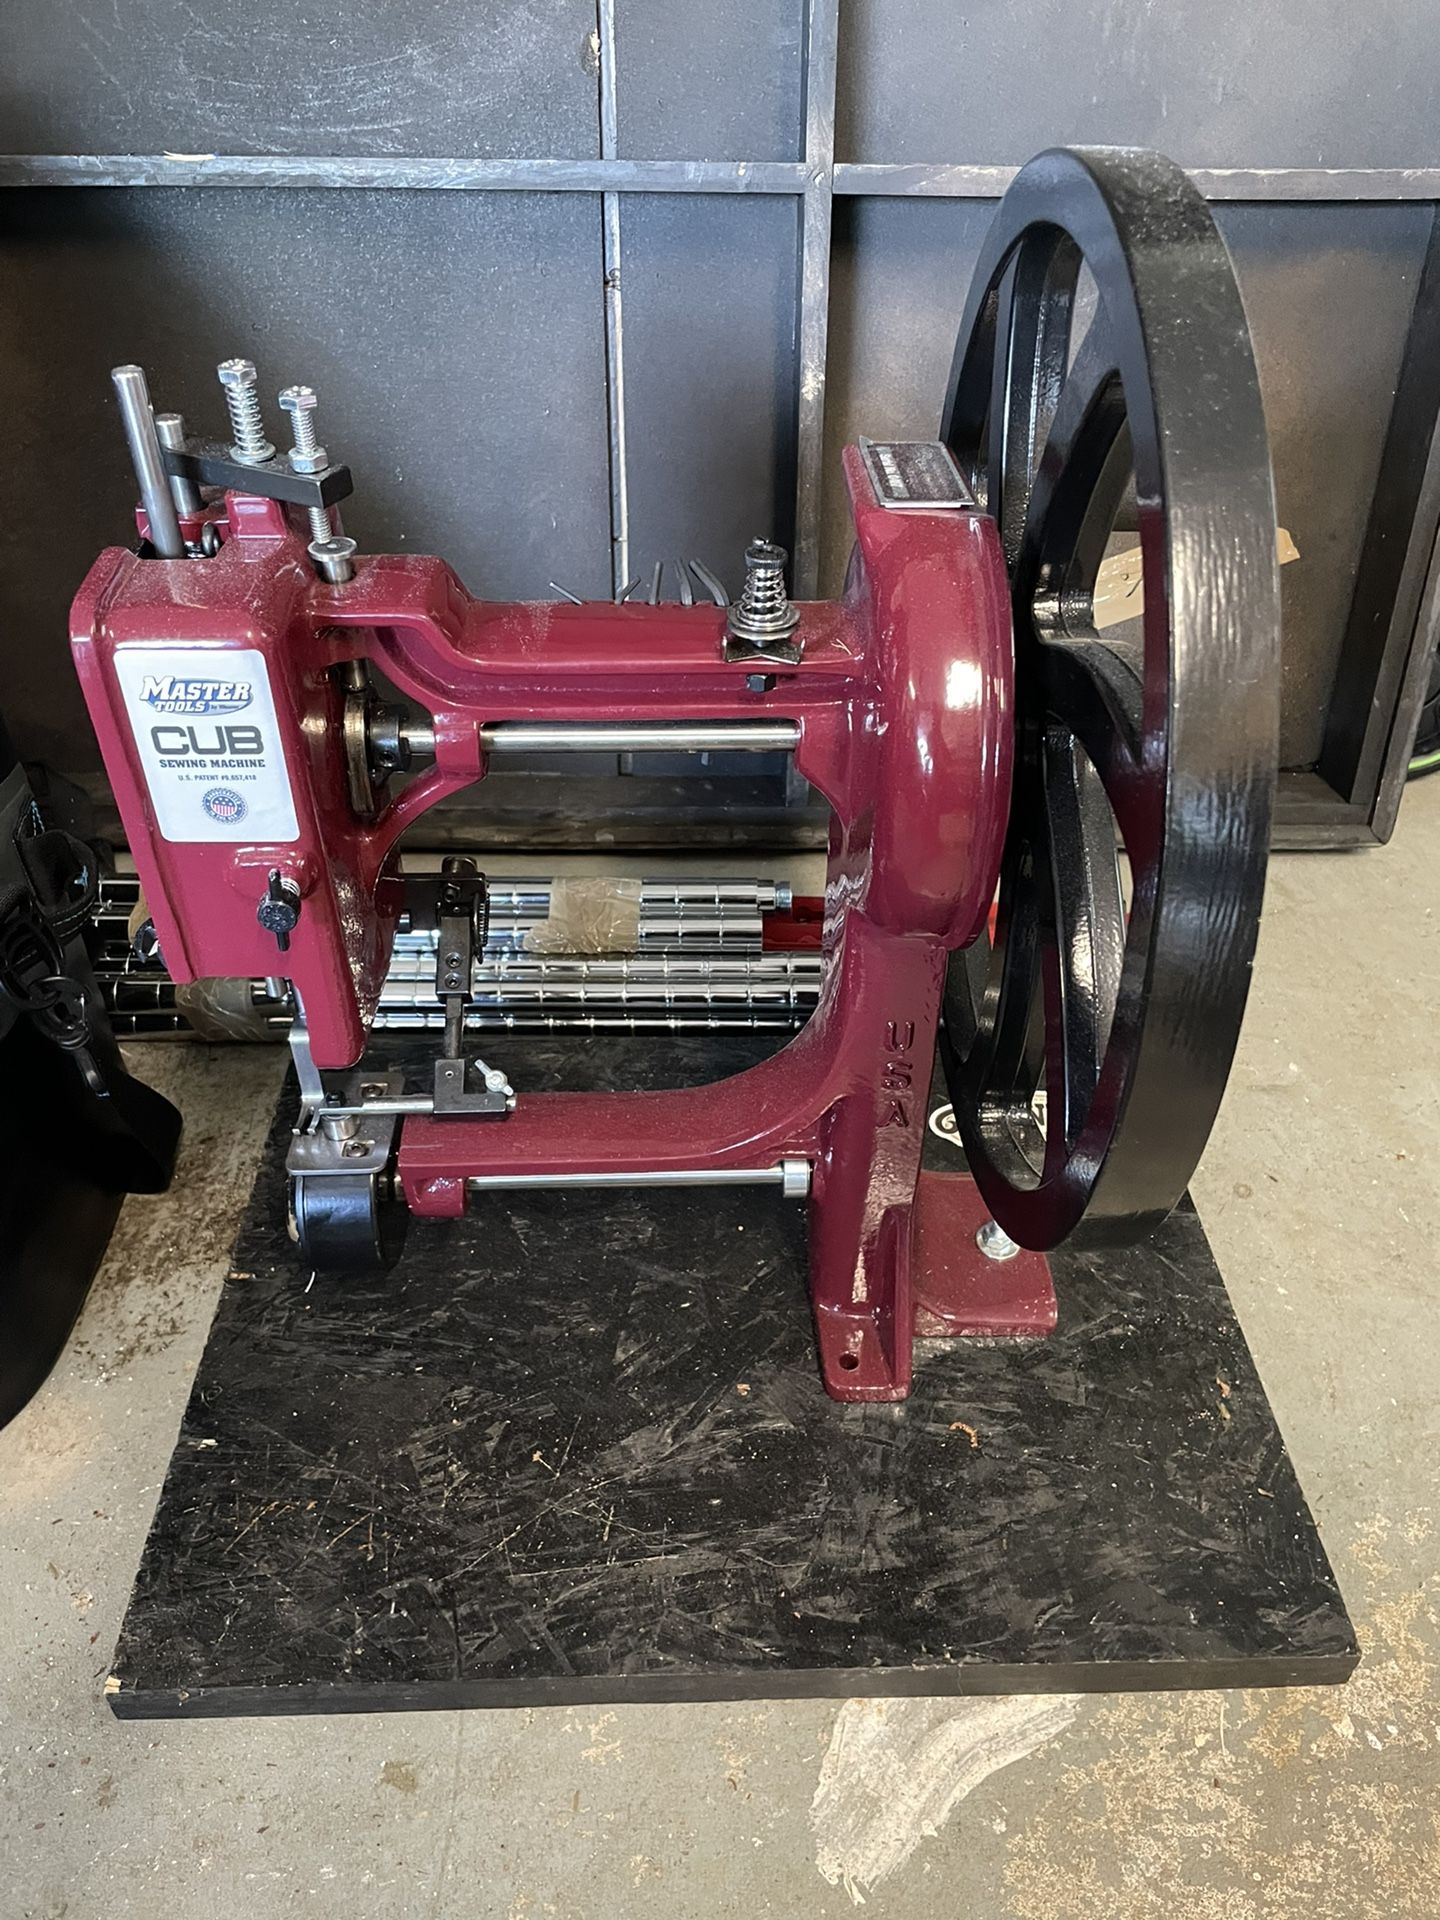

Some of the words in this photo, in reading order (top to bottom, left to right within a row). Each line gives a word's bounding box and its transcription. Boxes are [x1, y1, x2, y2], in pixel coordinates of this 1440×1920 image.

[139, 675, 251, 701] MASTER
[154, 700, 207, 713] TOOLS
[150, 725, 264, 755] CUB
[159, 759, 207, 768] SEWING
[210, 759, 266, 768] MACHINE
